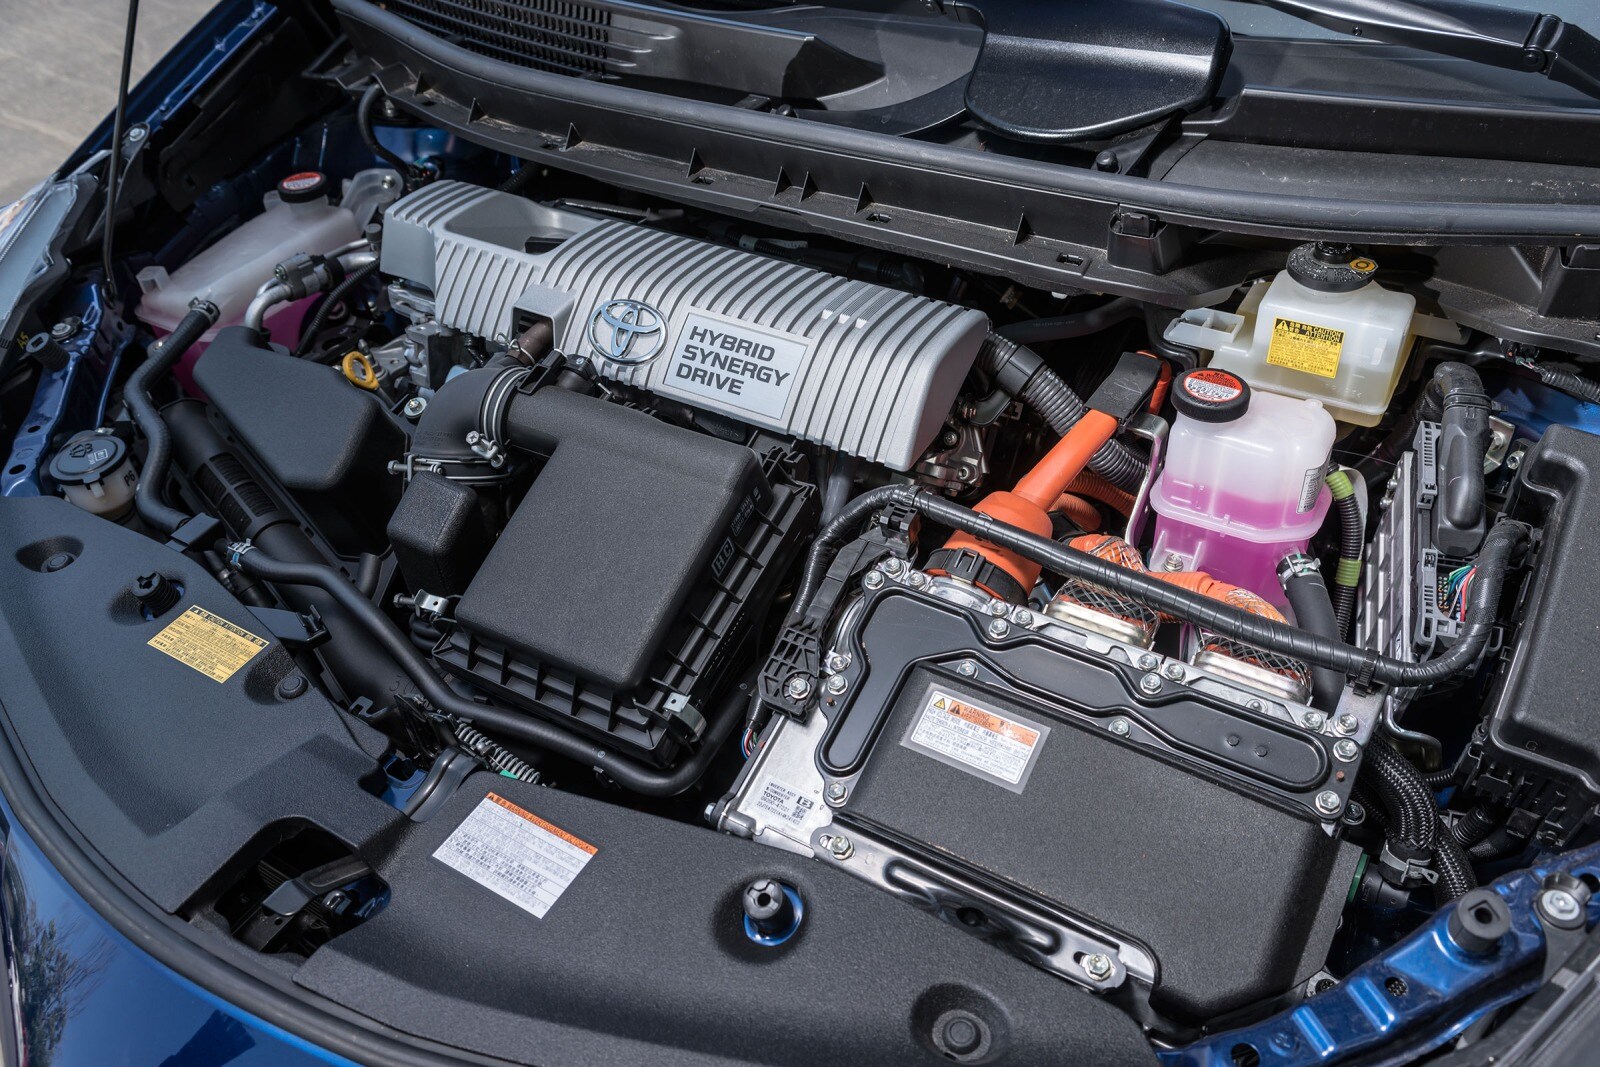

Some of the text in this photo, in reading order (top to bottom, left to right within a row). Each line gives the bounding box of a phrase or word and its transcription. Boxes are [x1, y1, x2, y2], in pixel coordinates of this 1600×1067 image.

[1305, 330, 1340, 342] ATTENTION
[1313, 327, 1341, 337] CAUTION
[689, 325, 776, 362] HYBRID
[682, 344, 790, 387] SYNERGY
[675, 362, 745, 396] DRIVE
[963, 706, 990, 720] WARNING
[769, 782, 786, 792] INVERTER
[763, 791, 784, 804] TOYOTA
